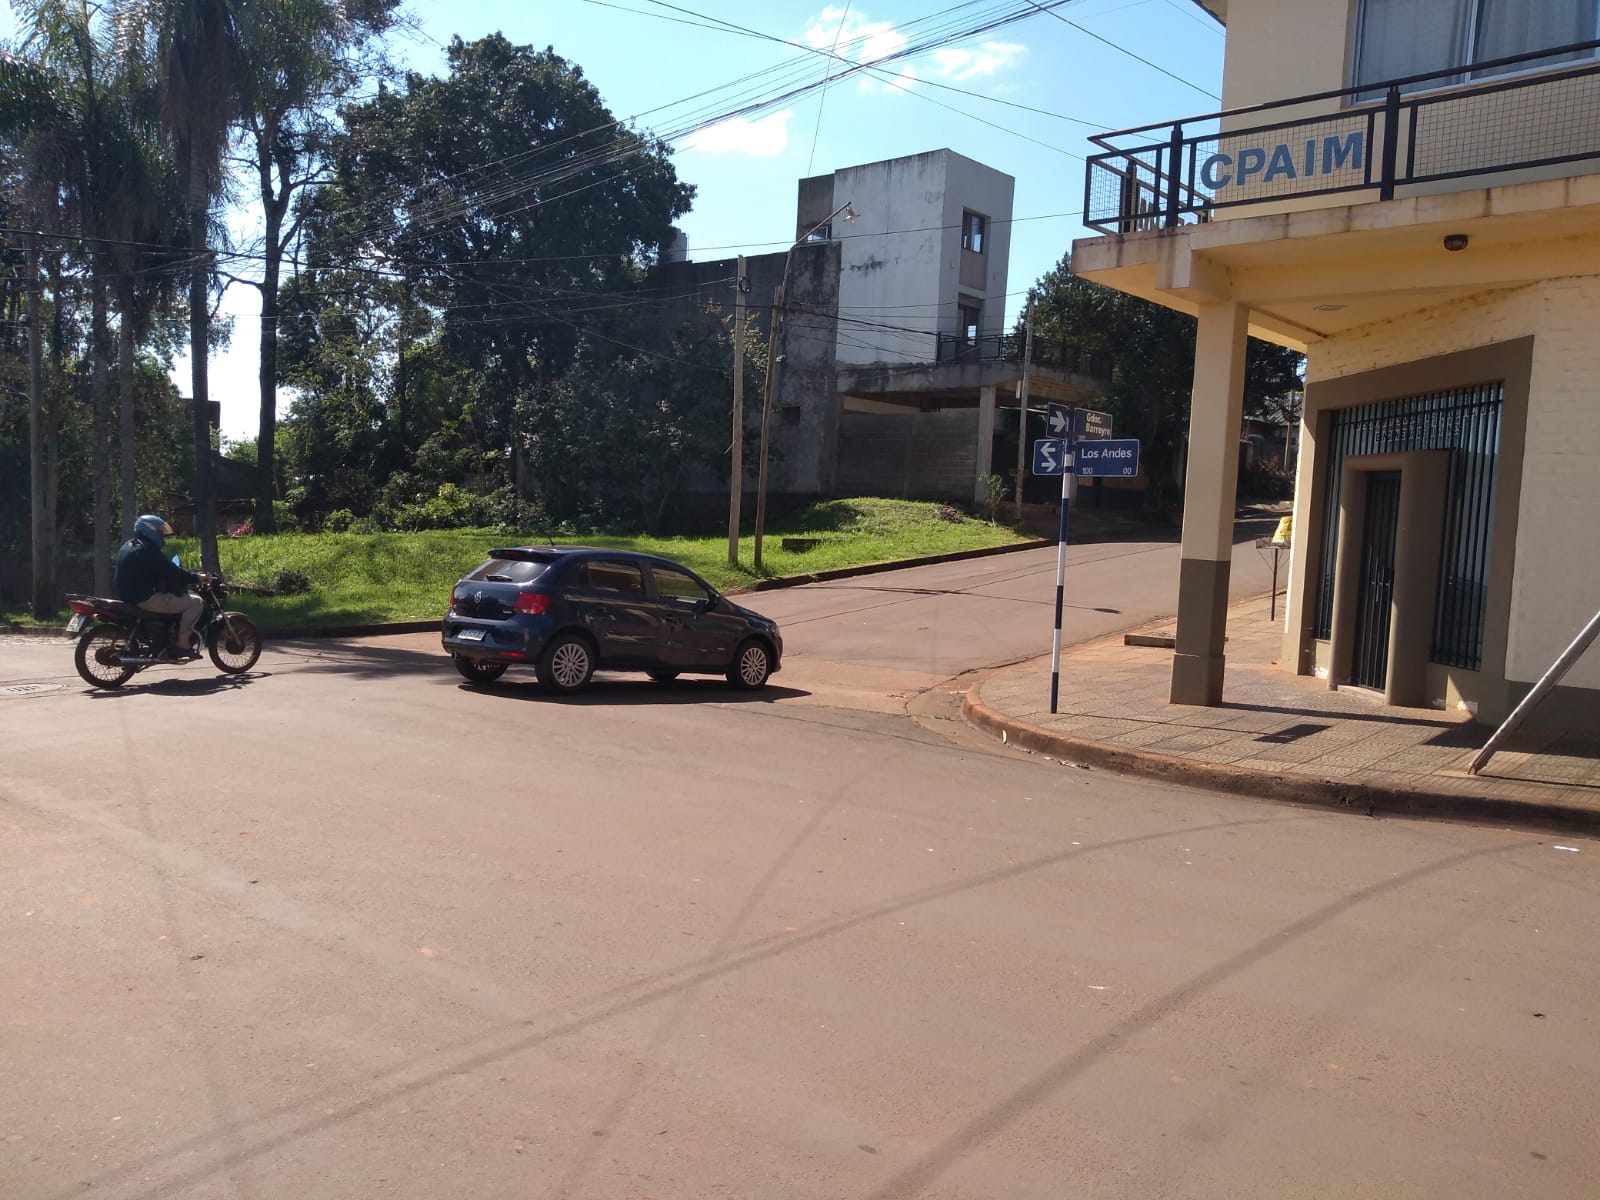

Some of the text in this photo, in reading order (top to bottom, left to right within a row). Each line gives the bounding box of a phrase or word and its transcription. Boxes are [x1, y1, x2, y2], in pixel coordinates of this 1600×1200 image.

[1200, 131, 1364, 190] CPAIM
[1086, 423, 1111, 436] Barreyro
[1081, 448, 1132, 458] Los Andes
